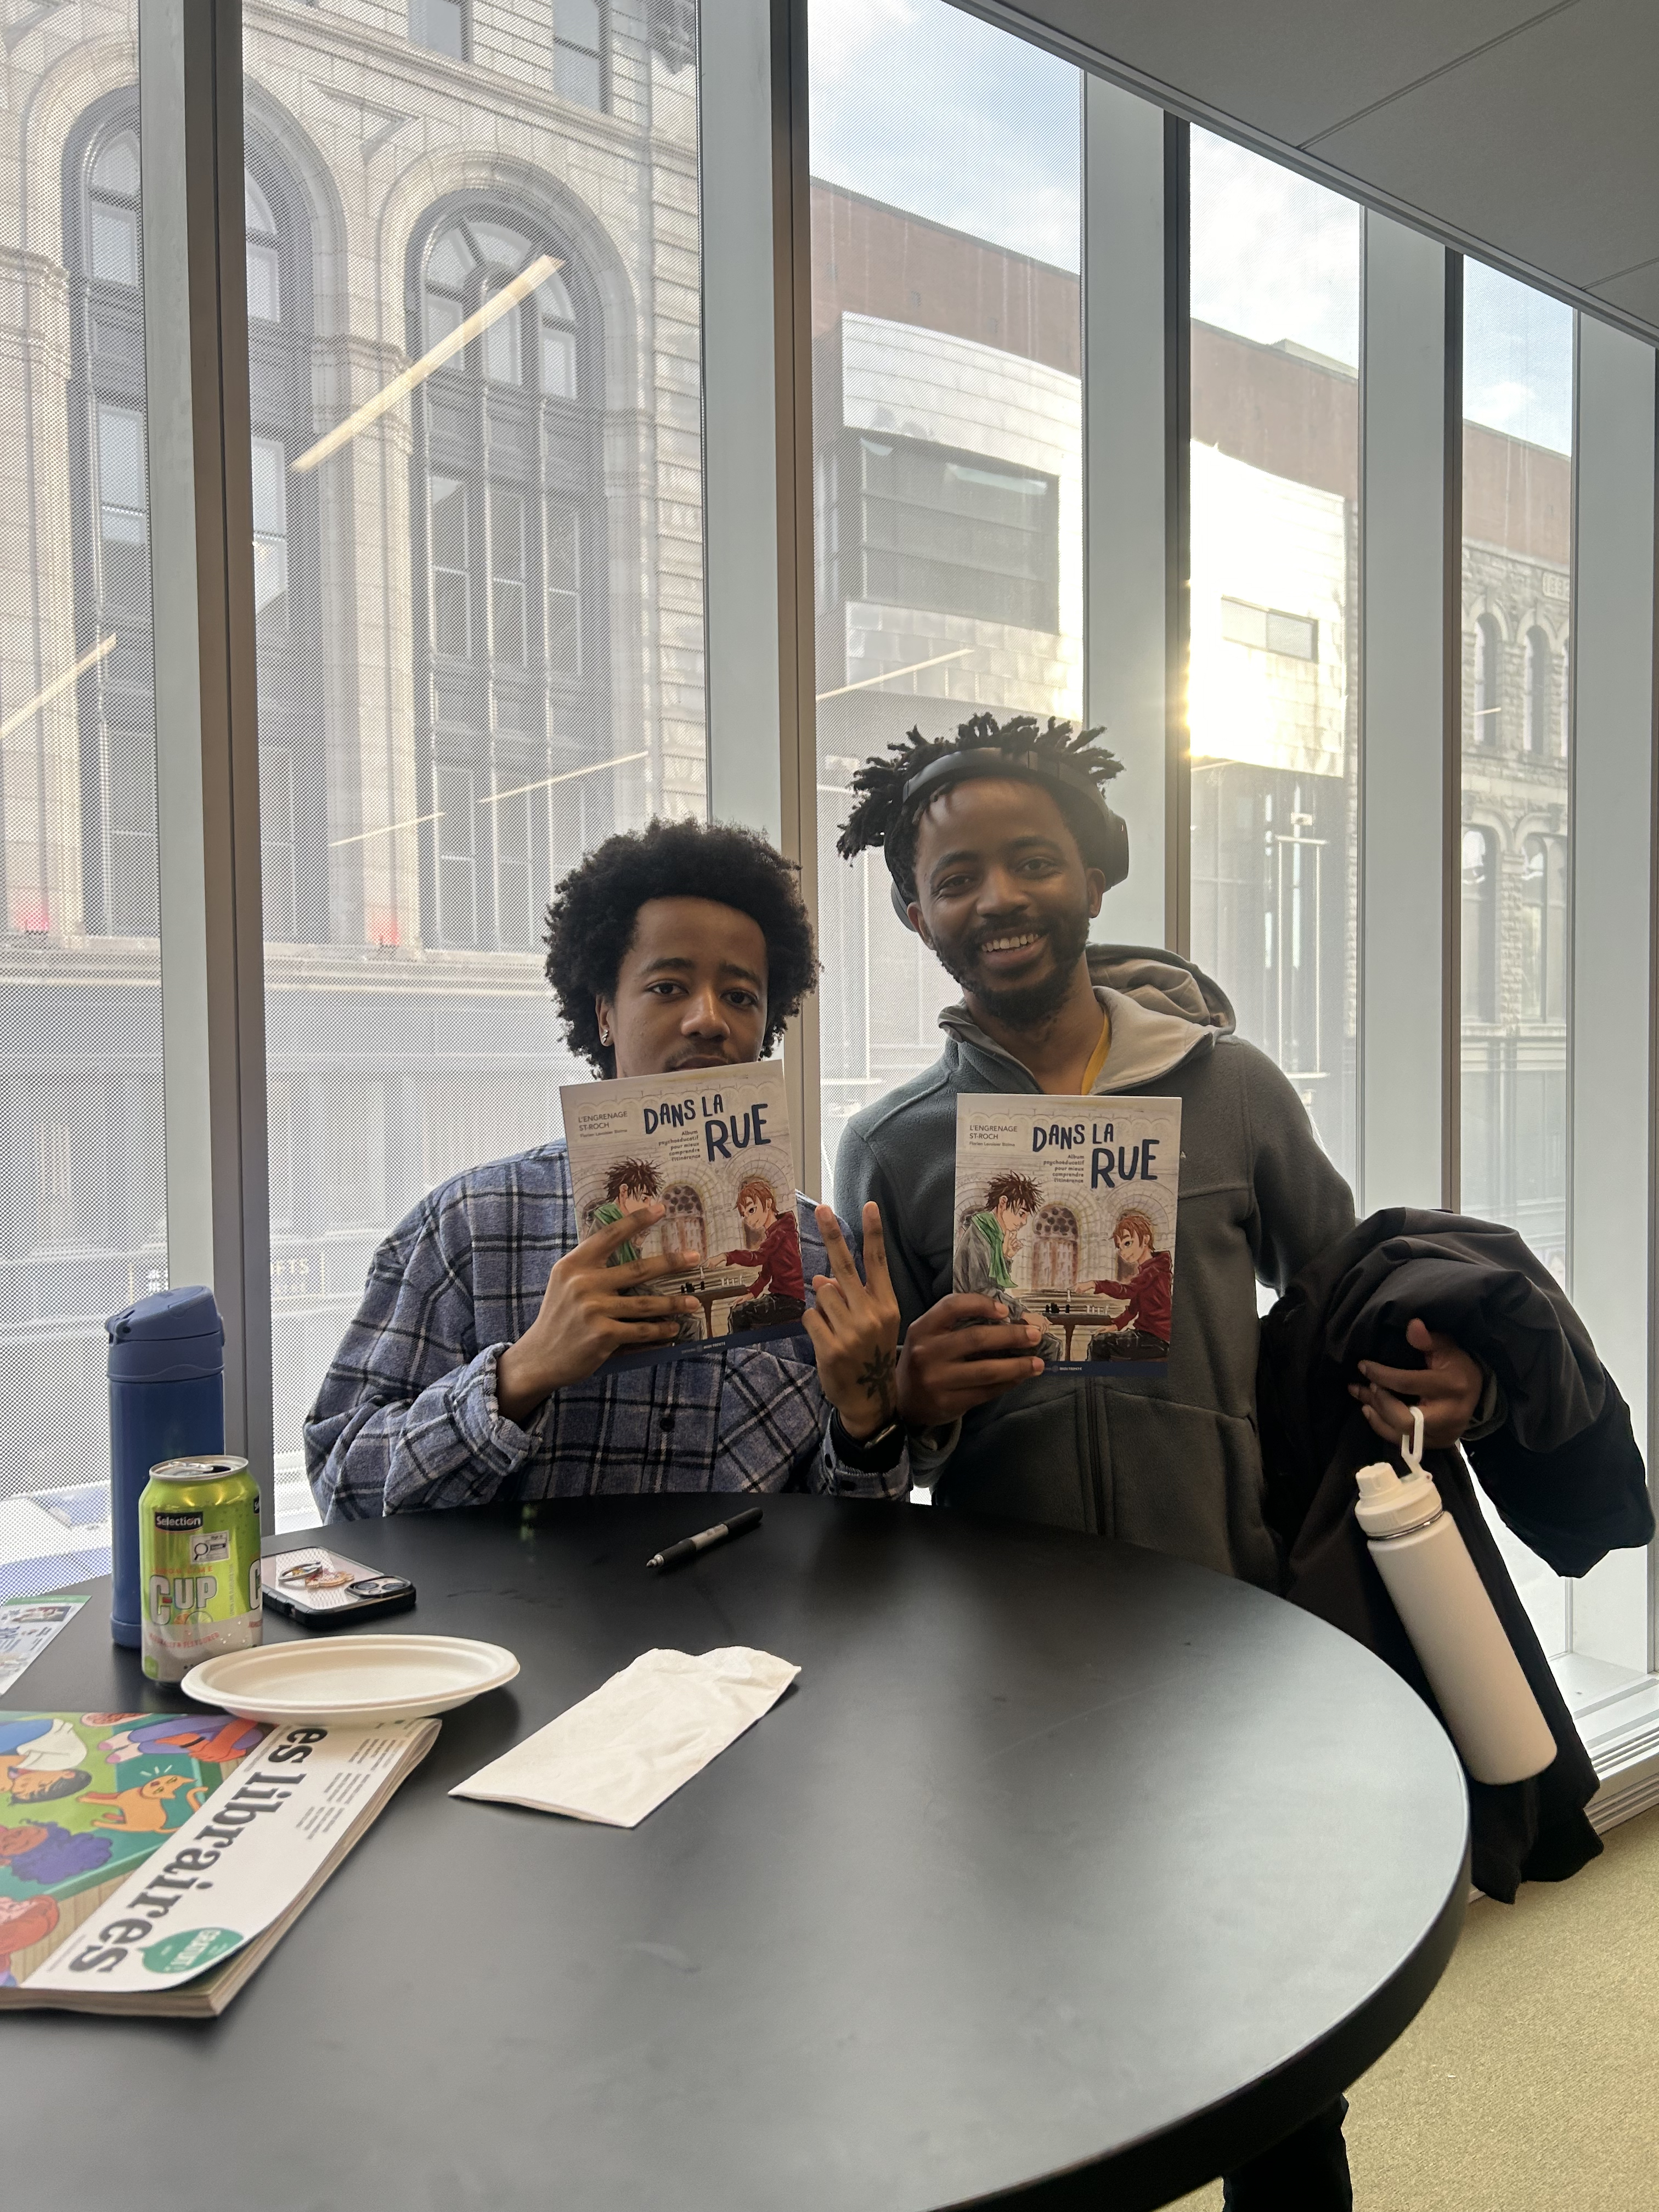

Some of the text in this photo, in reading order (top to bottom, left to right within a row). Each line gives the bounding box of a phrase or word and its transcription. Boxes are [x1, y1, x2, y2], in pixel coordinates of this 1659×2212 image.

[578, 1111, 628, 1123] L'ENGRENAGE
[579, 1122, 610, 1131] ST-ROCH
[644, 1094, 723, 1135] DANS LA
[704, 1103, 771, 1162] RUE
[1032, 1124, 1114, 1152] DANS LA
[1091, 1139, 1160, 1188] RUE
[156, 1516, 201, 1526] Selection
[149, 1575, 217, 1626] CUP
[69, 1728, 328, 1972] es libraires
